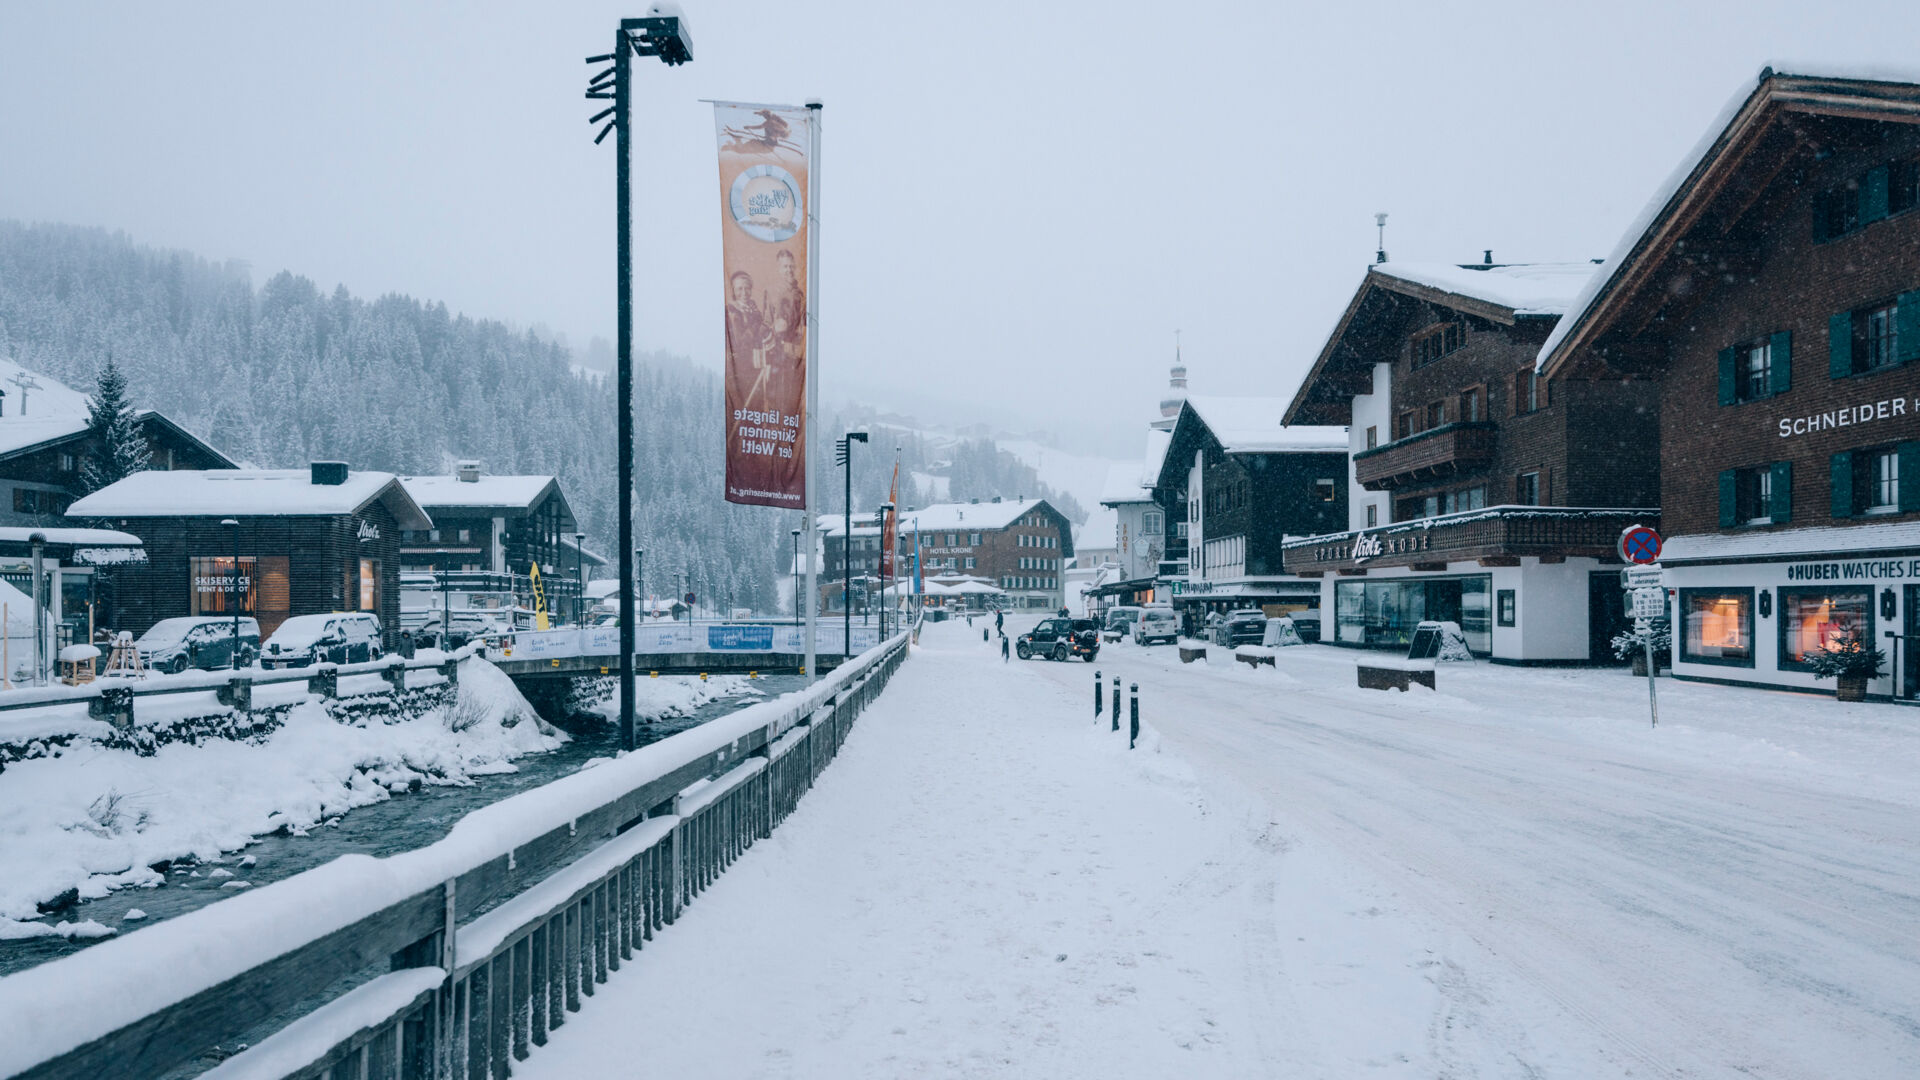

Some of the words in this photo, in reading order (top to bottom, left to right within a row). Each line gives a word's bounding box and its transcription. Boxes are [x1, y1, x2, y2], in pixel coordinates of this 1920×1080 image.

[1778, 397, 1906, 437] SCHNEIDER
[1314, 546, 1348, 560] SPORT
[1388, 535, 1428, 553] MODE
[1796, 563, 1840, 580] HUBER
[1842, 559, 1904, 579] WATCHES
[194, 576, 251, 585] SKISERVCE
[197, 585, 217, 593] RENT
[217, 585, 224, 593] &
[224, 585, 249, 593] DEOT
